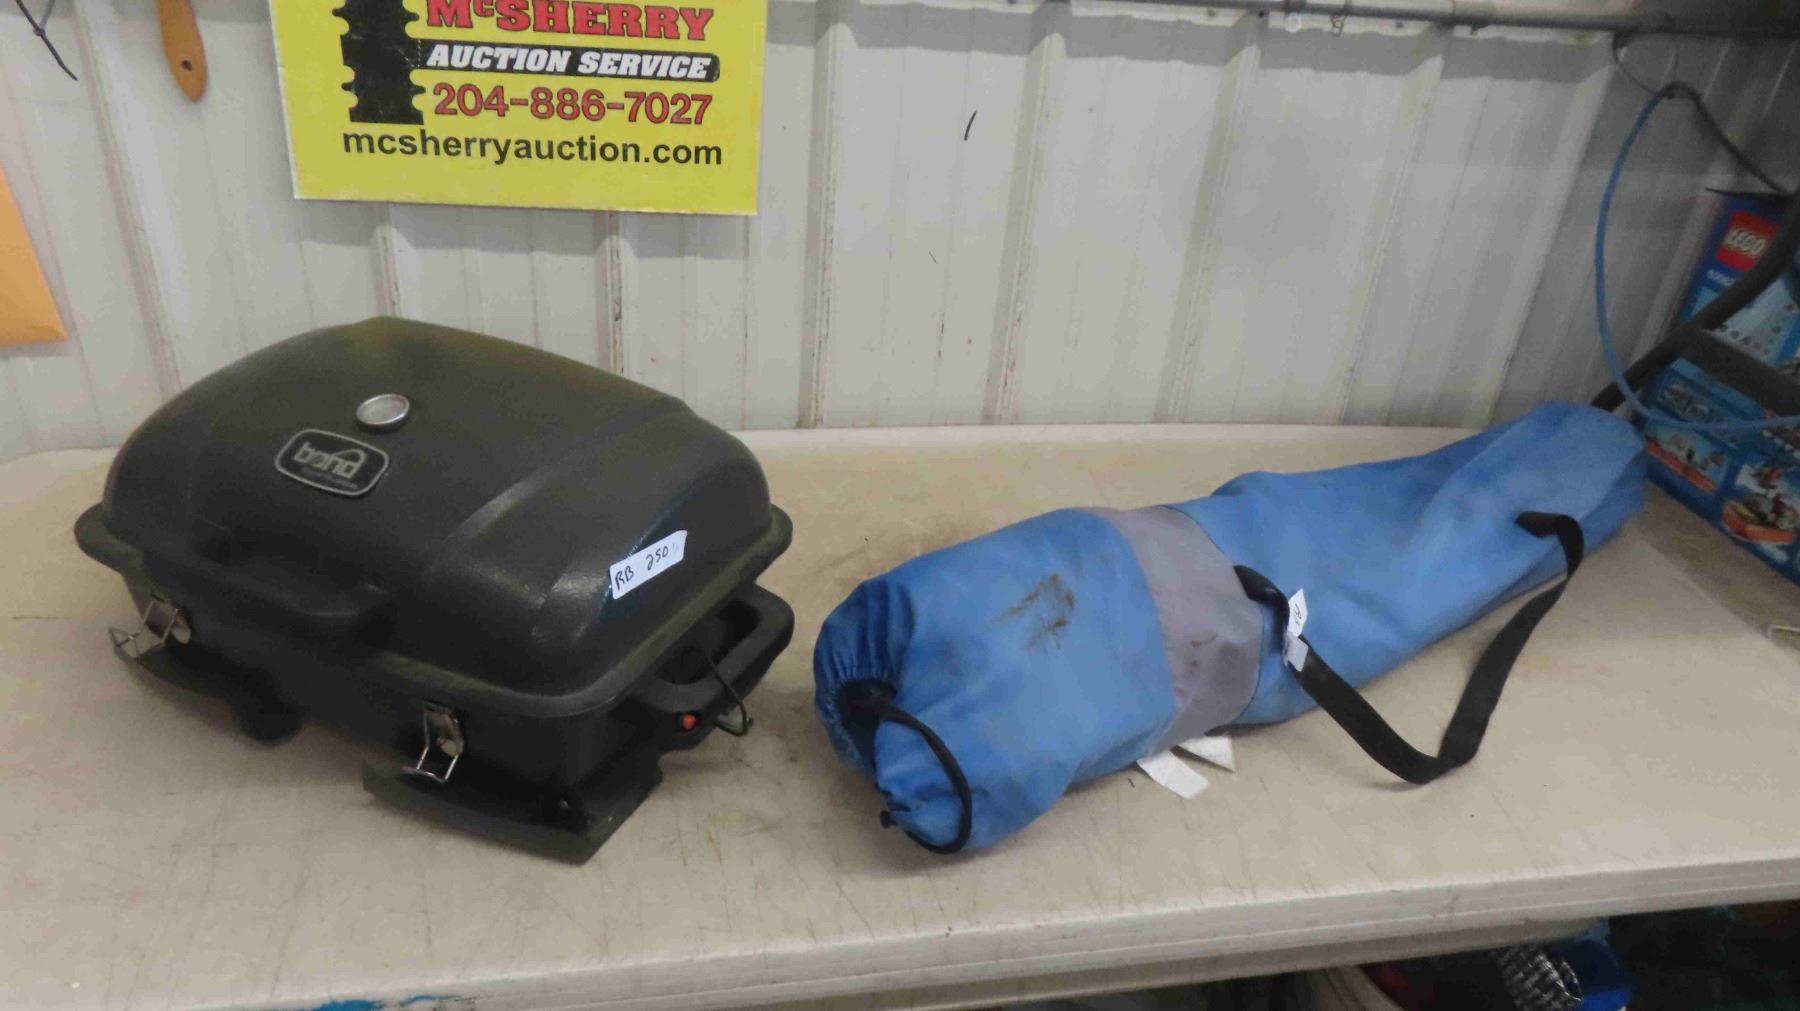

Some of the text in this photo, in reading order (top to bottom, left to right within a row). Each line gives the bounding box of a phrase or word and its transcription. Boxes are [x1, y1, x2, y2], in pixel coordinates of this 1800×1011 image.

[426, 44, 714, 80] AUCTION SERVICE
[432, 83, 713, 125] 204-886-7027
[342, 130, 723, 165] mcsherryauction.com
[1725, 228, 1767, 256] LEGO
[614, 545, 669, 591] RB 250
